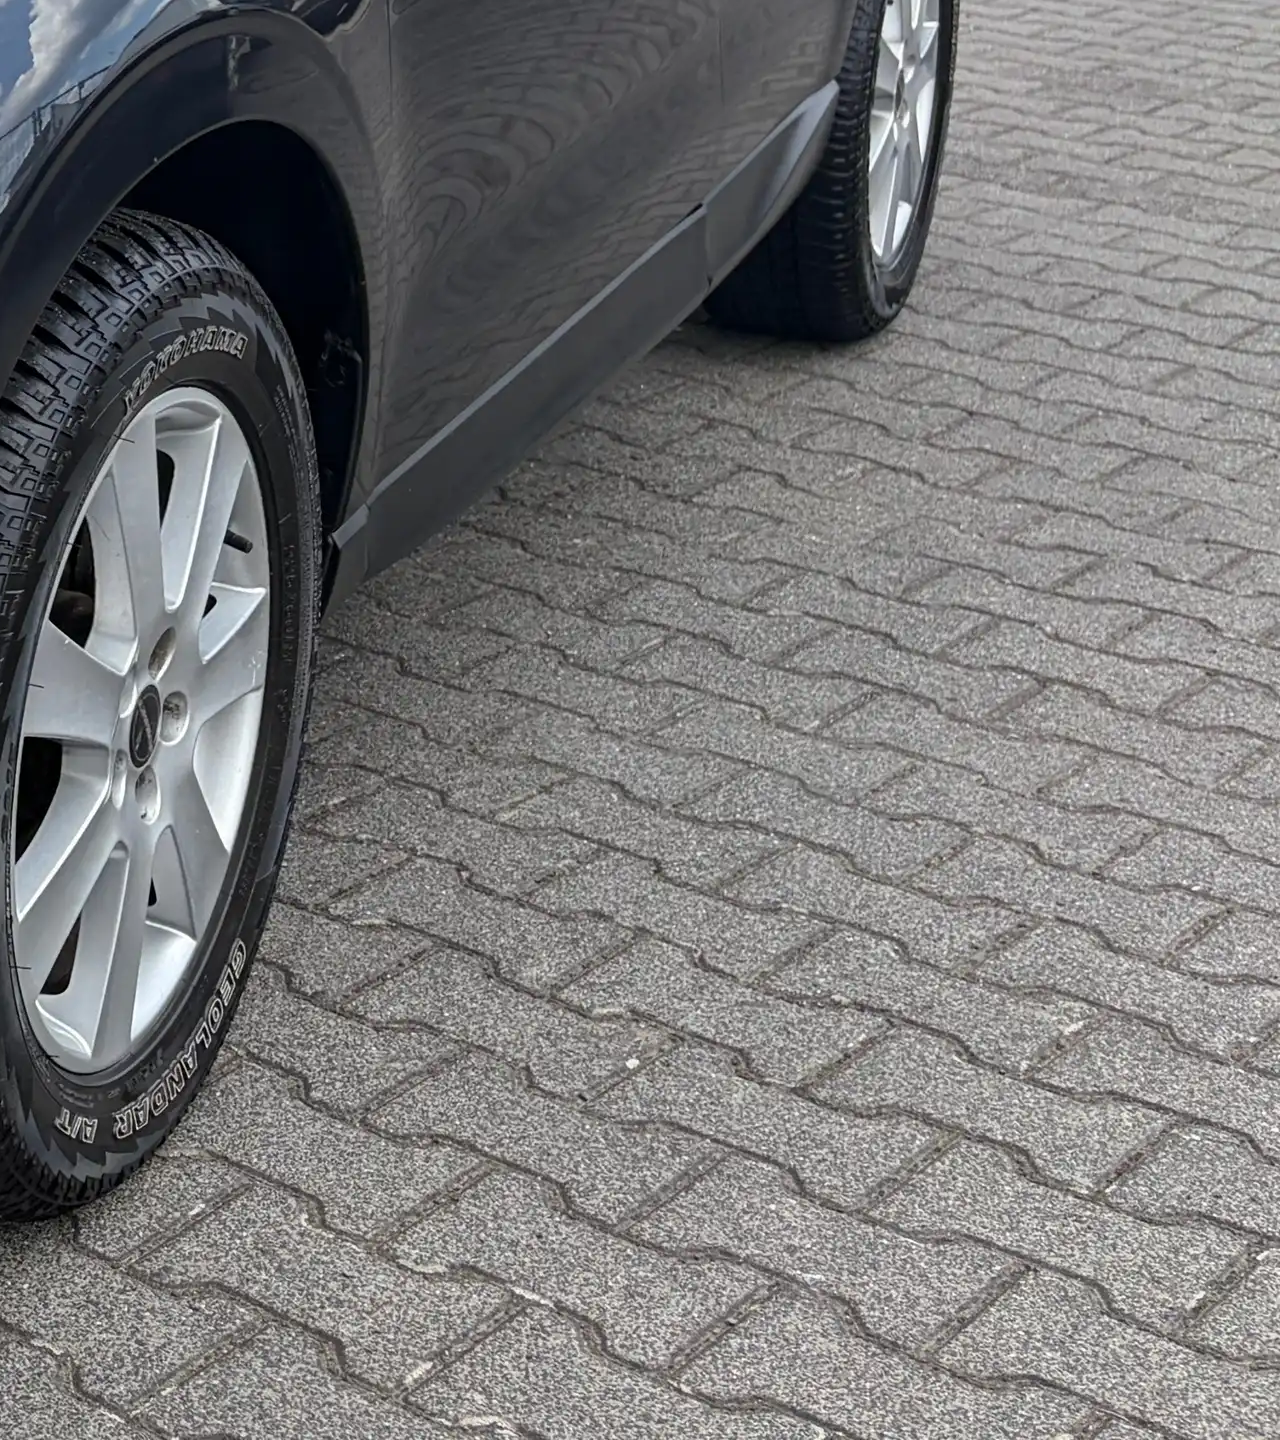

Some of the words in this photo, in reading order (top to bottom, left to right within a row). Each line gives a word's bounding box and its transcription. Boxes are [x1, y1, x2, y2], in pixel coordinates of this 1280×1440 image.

[123, 325, 248, 415] YOKOHAMA
[113, 937, 247, 1140] GEOLANDAR
[54, 1107, 98, 1144] A/T
